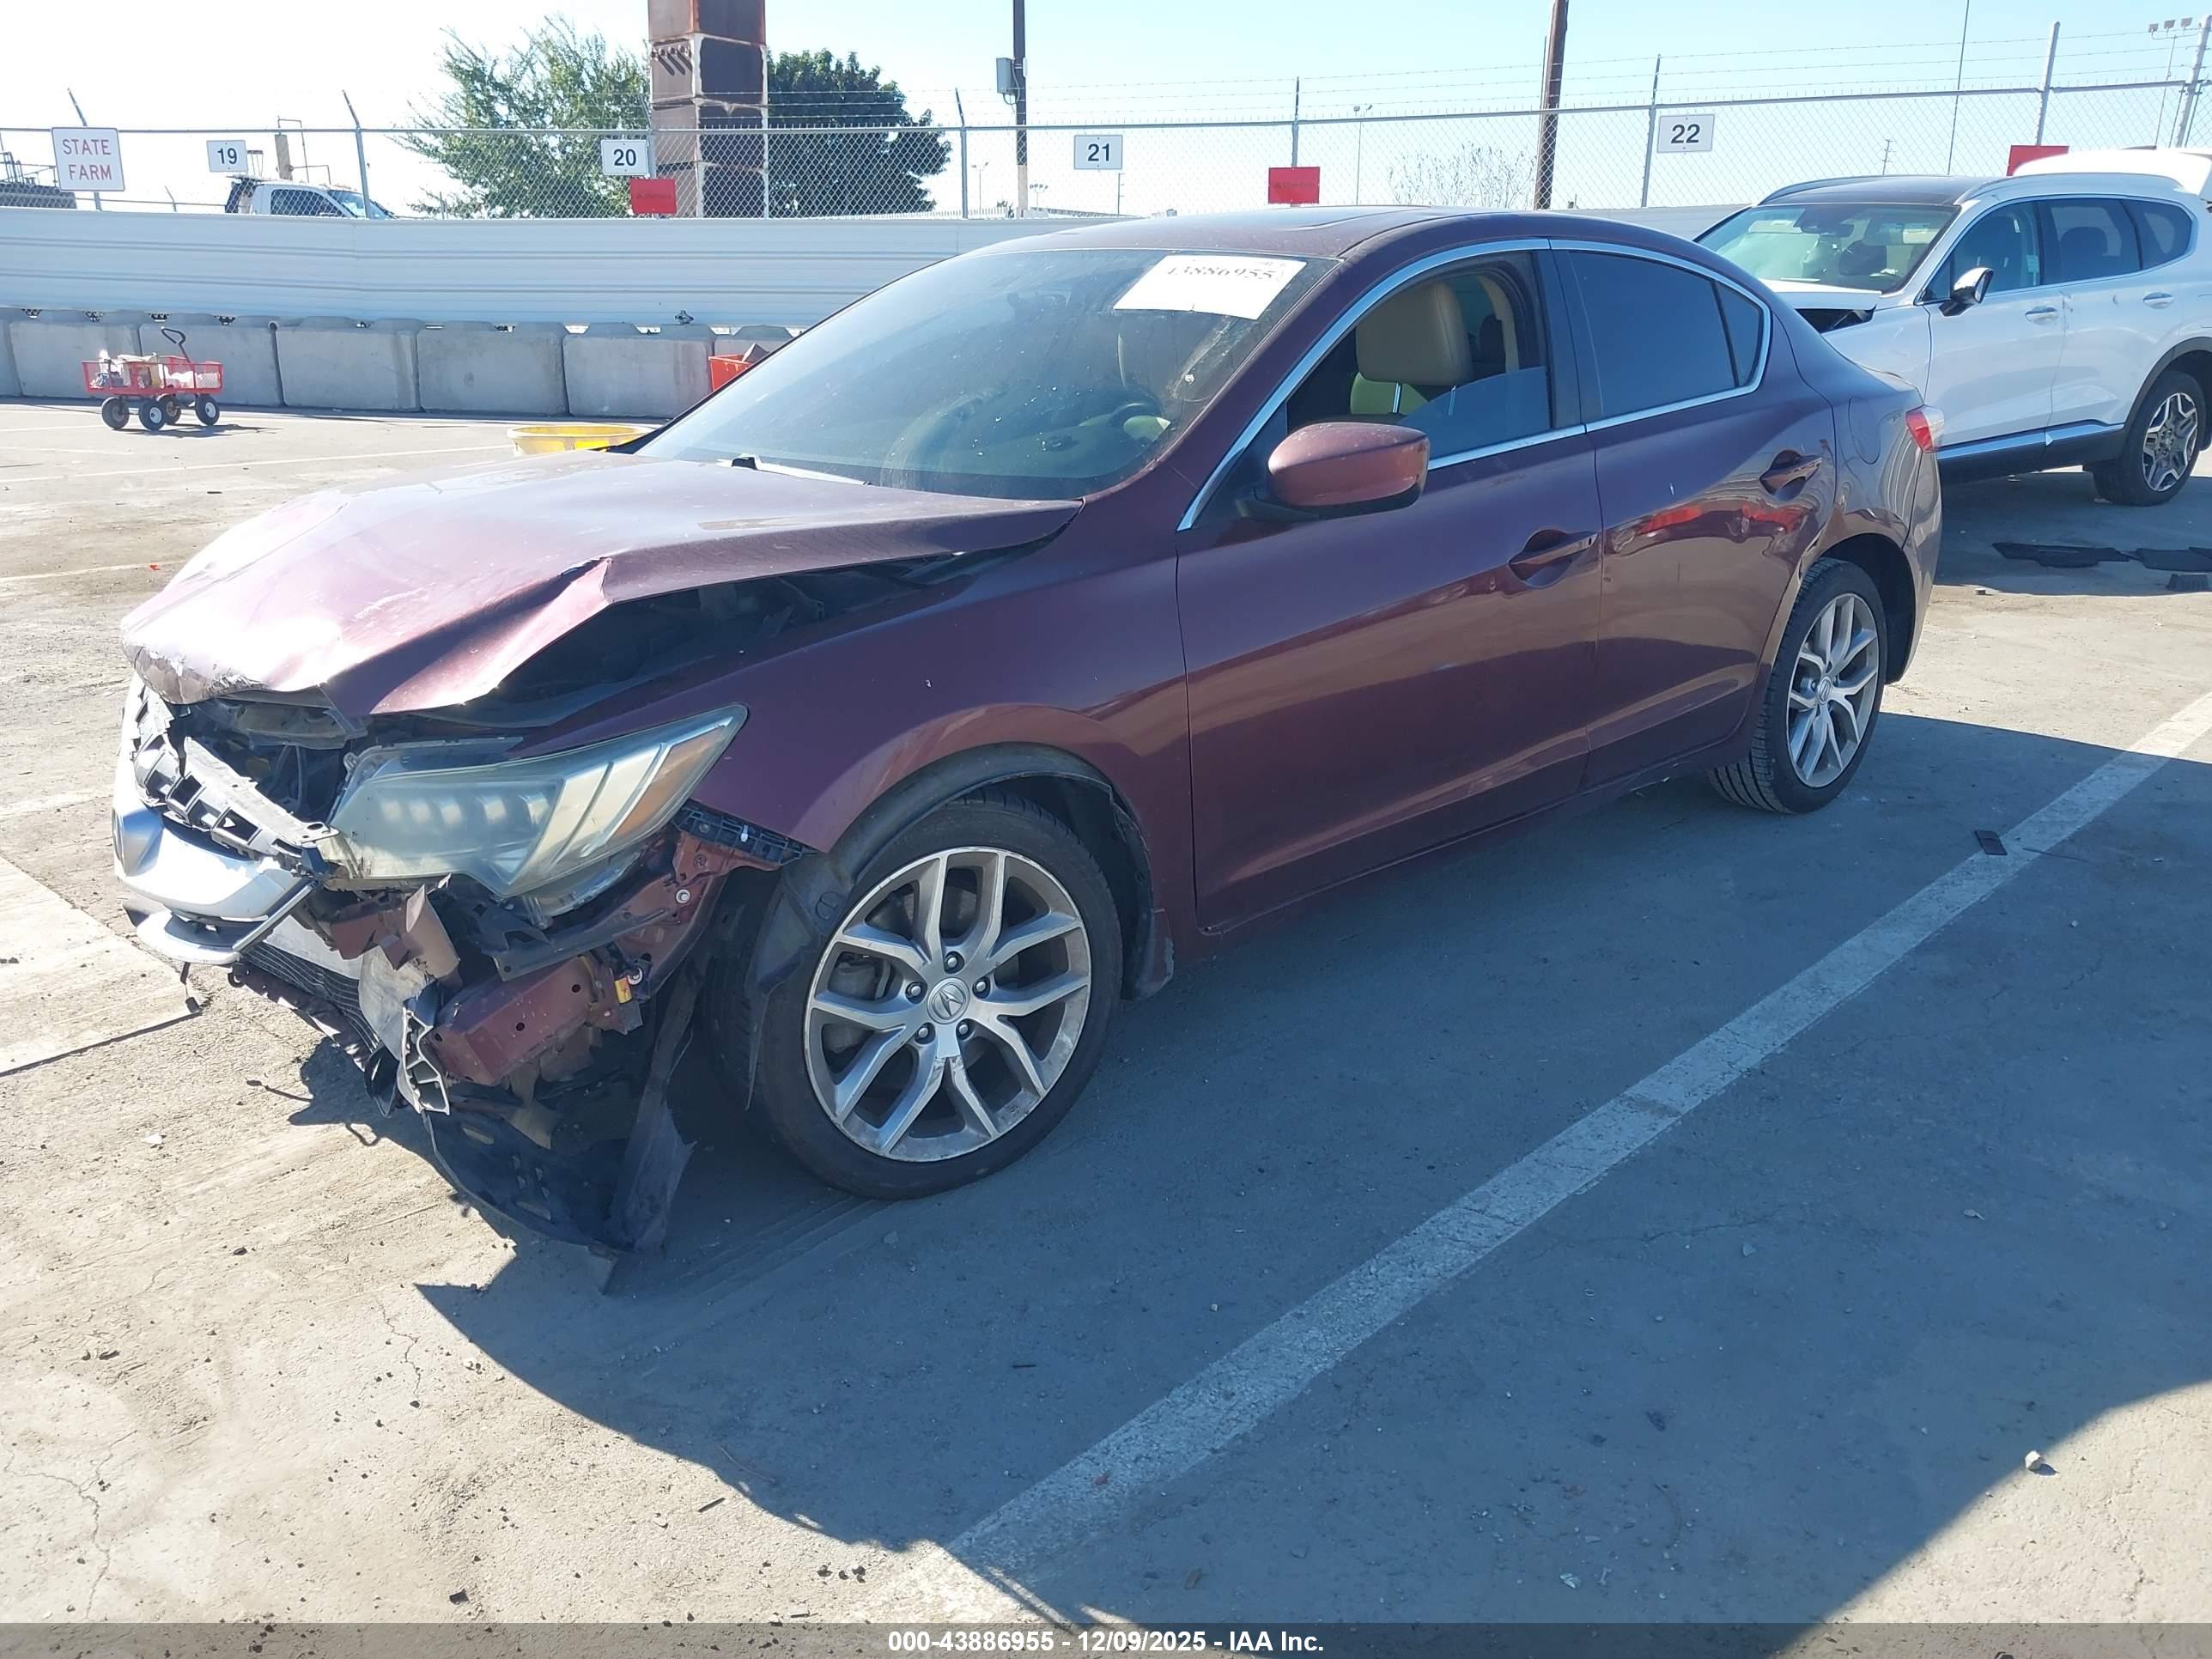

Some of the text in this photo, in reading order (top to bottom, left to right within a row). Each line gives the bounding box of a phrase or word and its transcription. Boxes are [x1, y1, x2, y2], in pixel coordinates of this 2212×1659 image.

[1671, 123, 1701, 144] 22
[63, 138, 112, 155] STATE
[1087, 143, 1111, 163] 21
[217, 147, 238, 165] 19
[612, 148, 637, 167] 20
[69, 164, 112, 180] FARM
